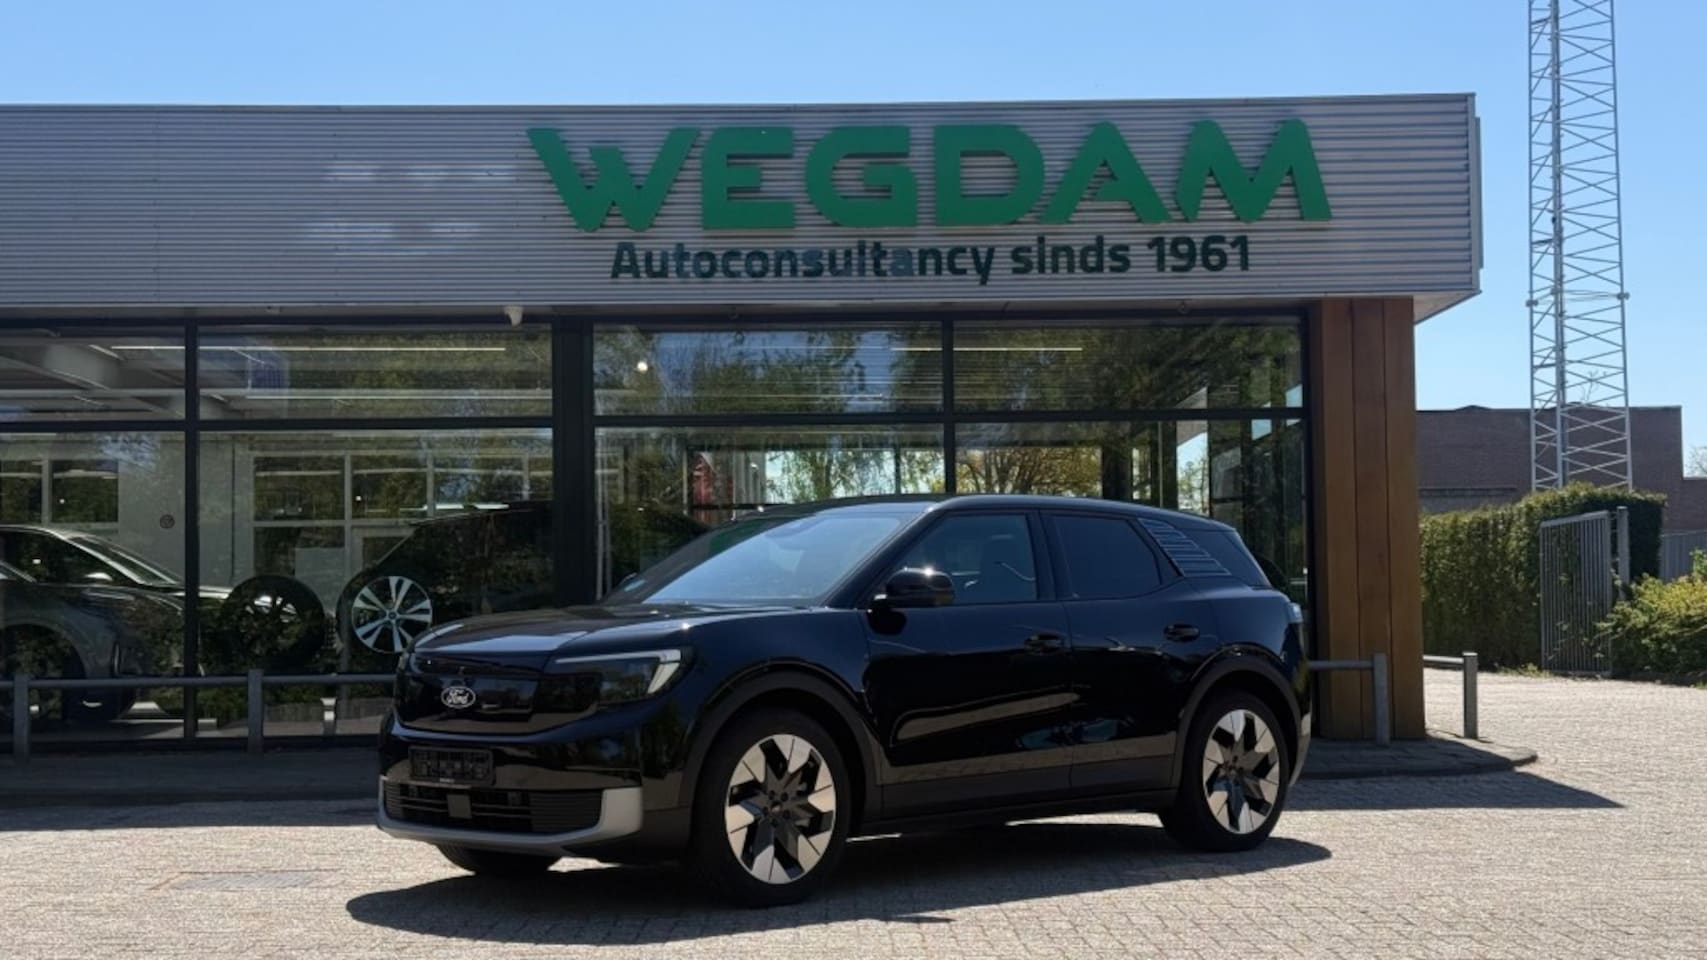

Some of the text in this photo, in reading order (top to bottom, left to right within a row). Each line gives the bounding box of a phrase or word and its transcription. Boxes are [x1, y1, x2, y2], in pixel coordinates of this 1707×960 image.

[527, 118, 1333, 232] WEGDAM
[611, 235, 1249, 286] Autoconsultancy sinds 1961
[445, 688, 471, 706] Ford
